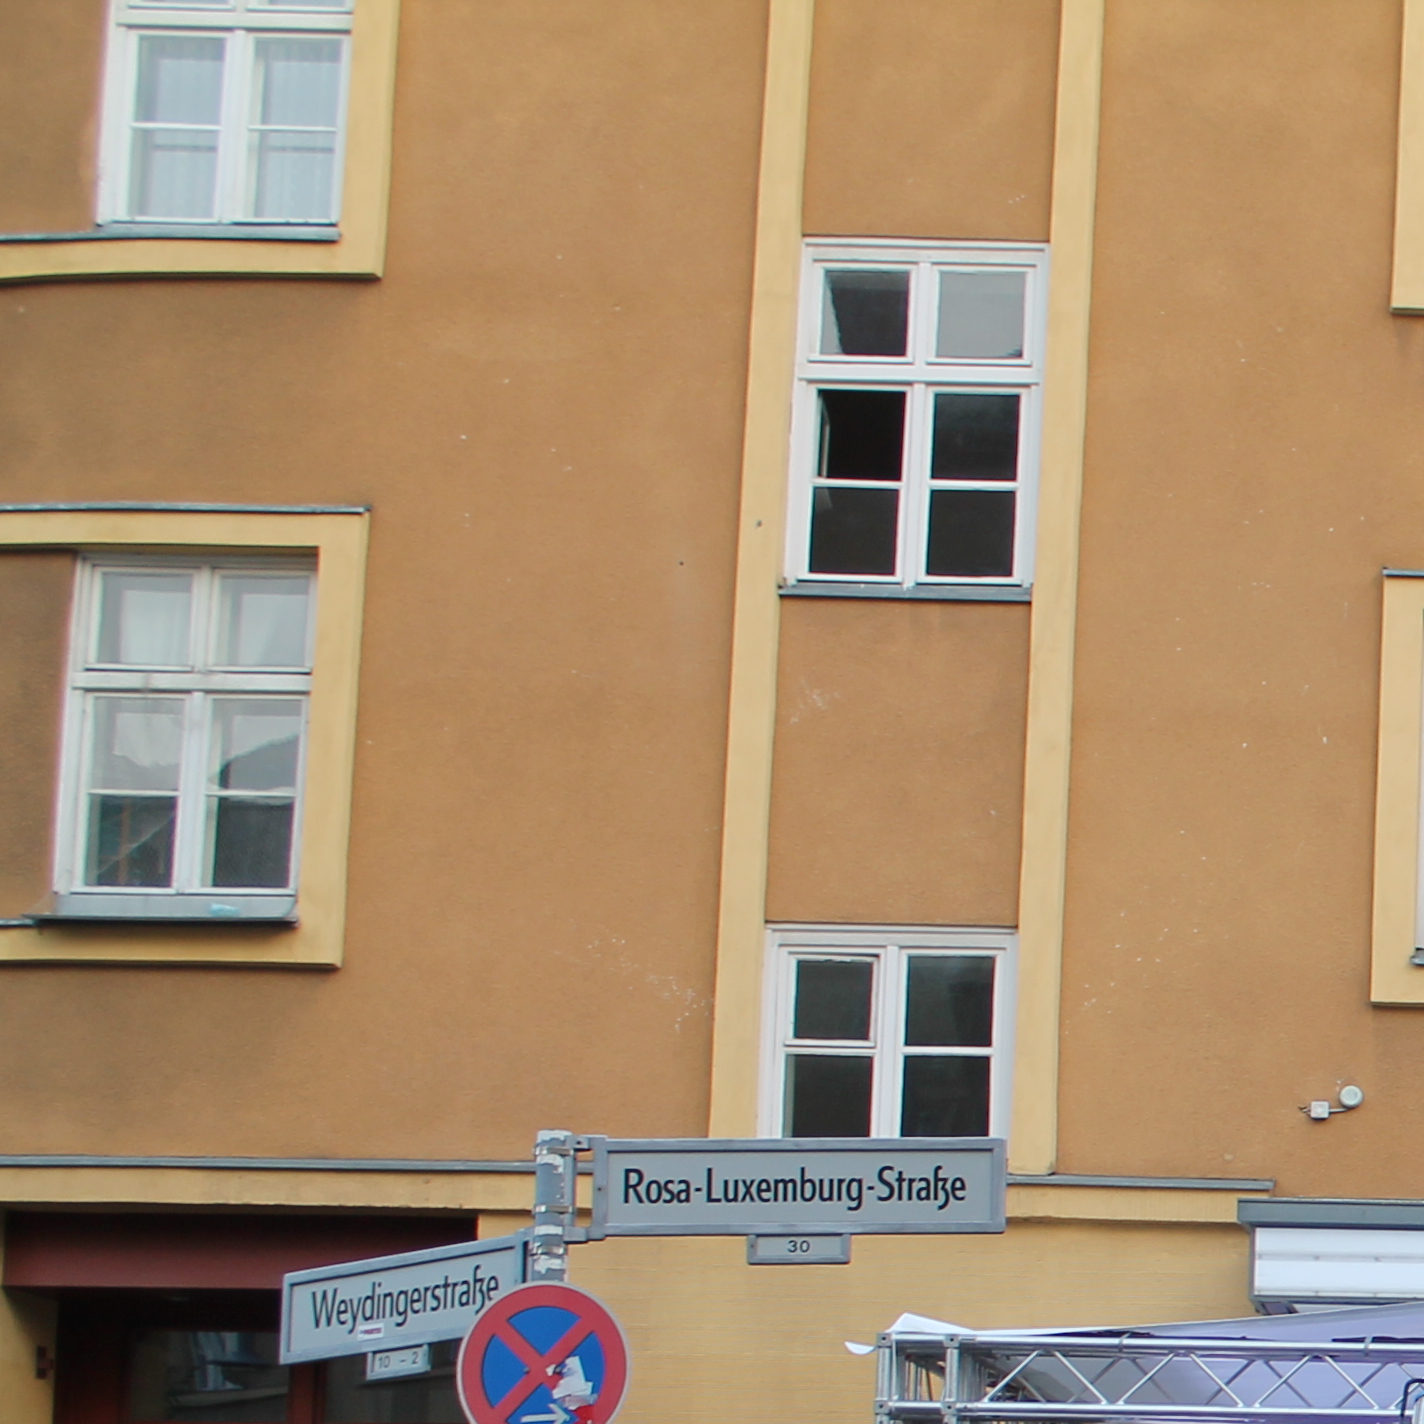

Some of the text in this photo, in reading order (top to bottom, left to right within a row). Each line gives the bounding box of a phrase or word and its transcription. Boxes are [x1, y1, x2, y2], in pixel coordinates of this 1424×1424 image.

[623, 1166, 967, 1211] Rosa-Luxemburg-Straße
[787, 1240, 811, 1254] 30
[311, 1264, 500, 1335] Weydingerstraße
